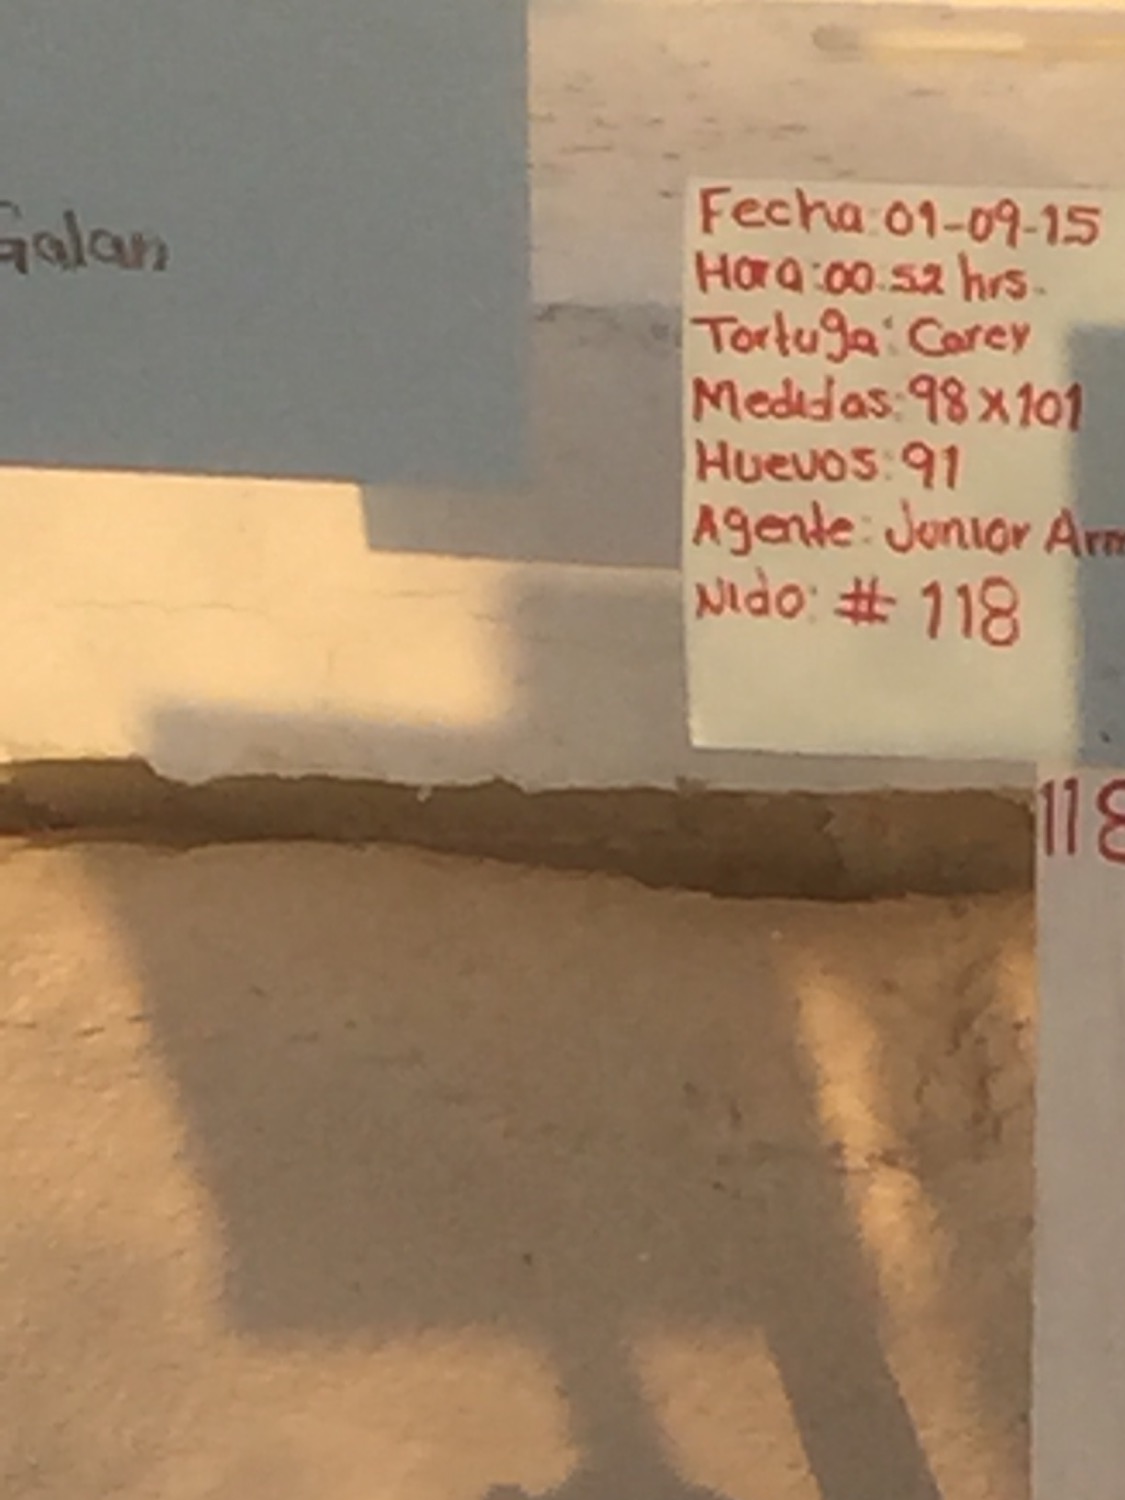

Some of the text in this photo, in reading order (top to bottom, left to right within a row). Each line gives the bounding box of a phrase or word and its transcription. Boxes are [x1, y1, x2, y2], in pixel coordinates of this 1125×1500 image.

[700, 186, 1101, 248] Fecha: 01-09-15
[690, 308, 897, 363] Tortuga:
[692, 375, 902, 424] Medidas:
[696, 438, 960, 489] Huevos: 91
[692, 500, 872, 556] Agente:
[921, 575, 1021, 647] 118
